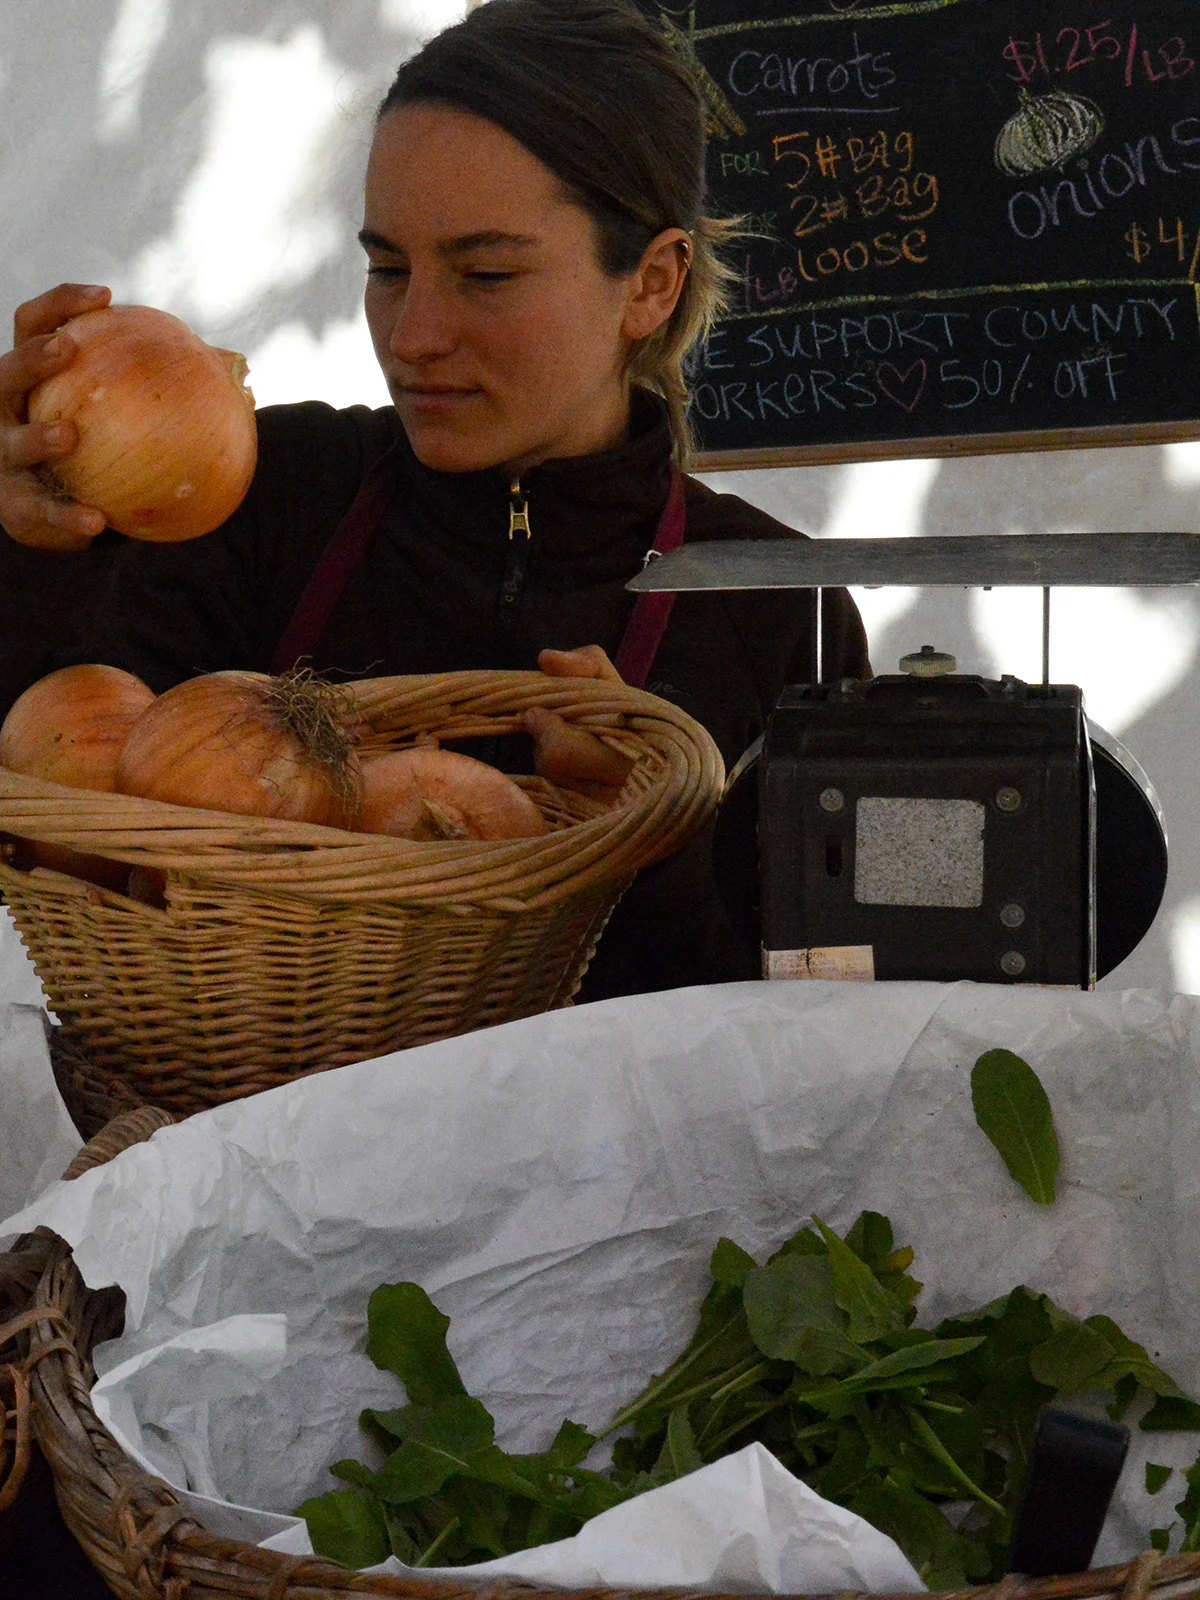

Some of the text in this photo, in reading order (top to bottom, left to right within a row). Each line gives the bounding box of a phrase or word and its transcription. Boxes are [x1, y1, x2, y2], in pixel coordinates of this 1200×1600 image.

[728, 32, 896, 97] Carrots
[1003, 20, 1195, 87] $1.25/LB
[798, 228, 928, 283] loose
[749, 308, 970, 367] SUPPORT
[984, 298, 1177, 347] COUNTY
[684, 353, 1128, 420] ORKERS 50% OFF
